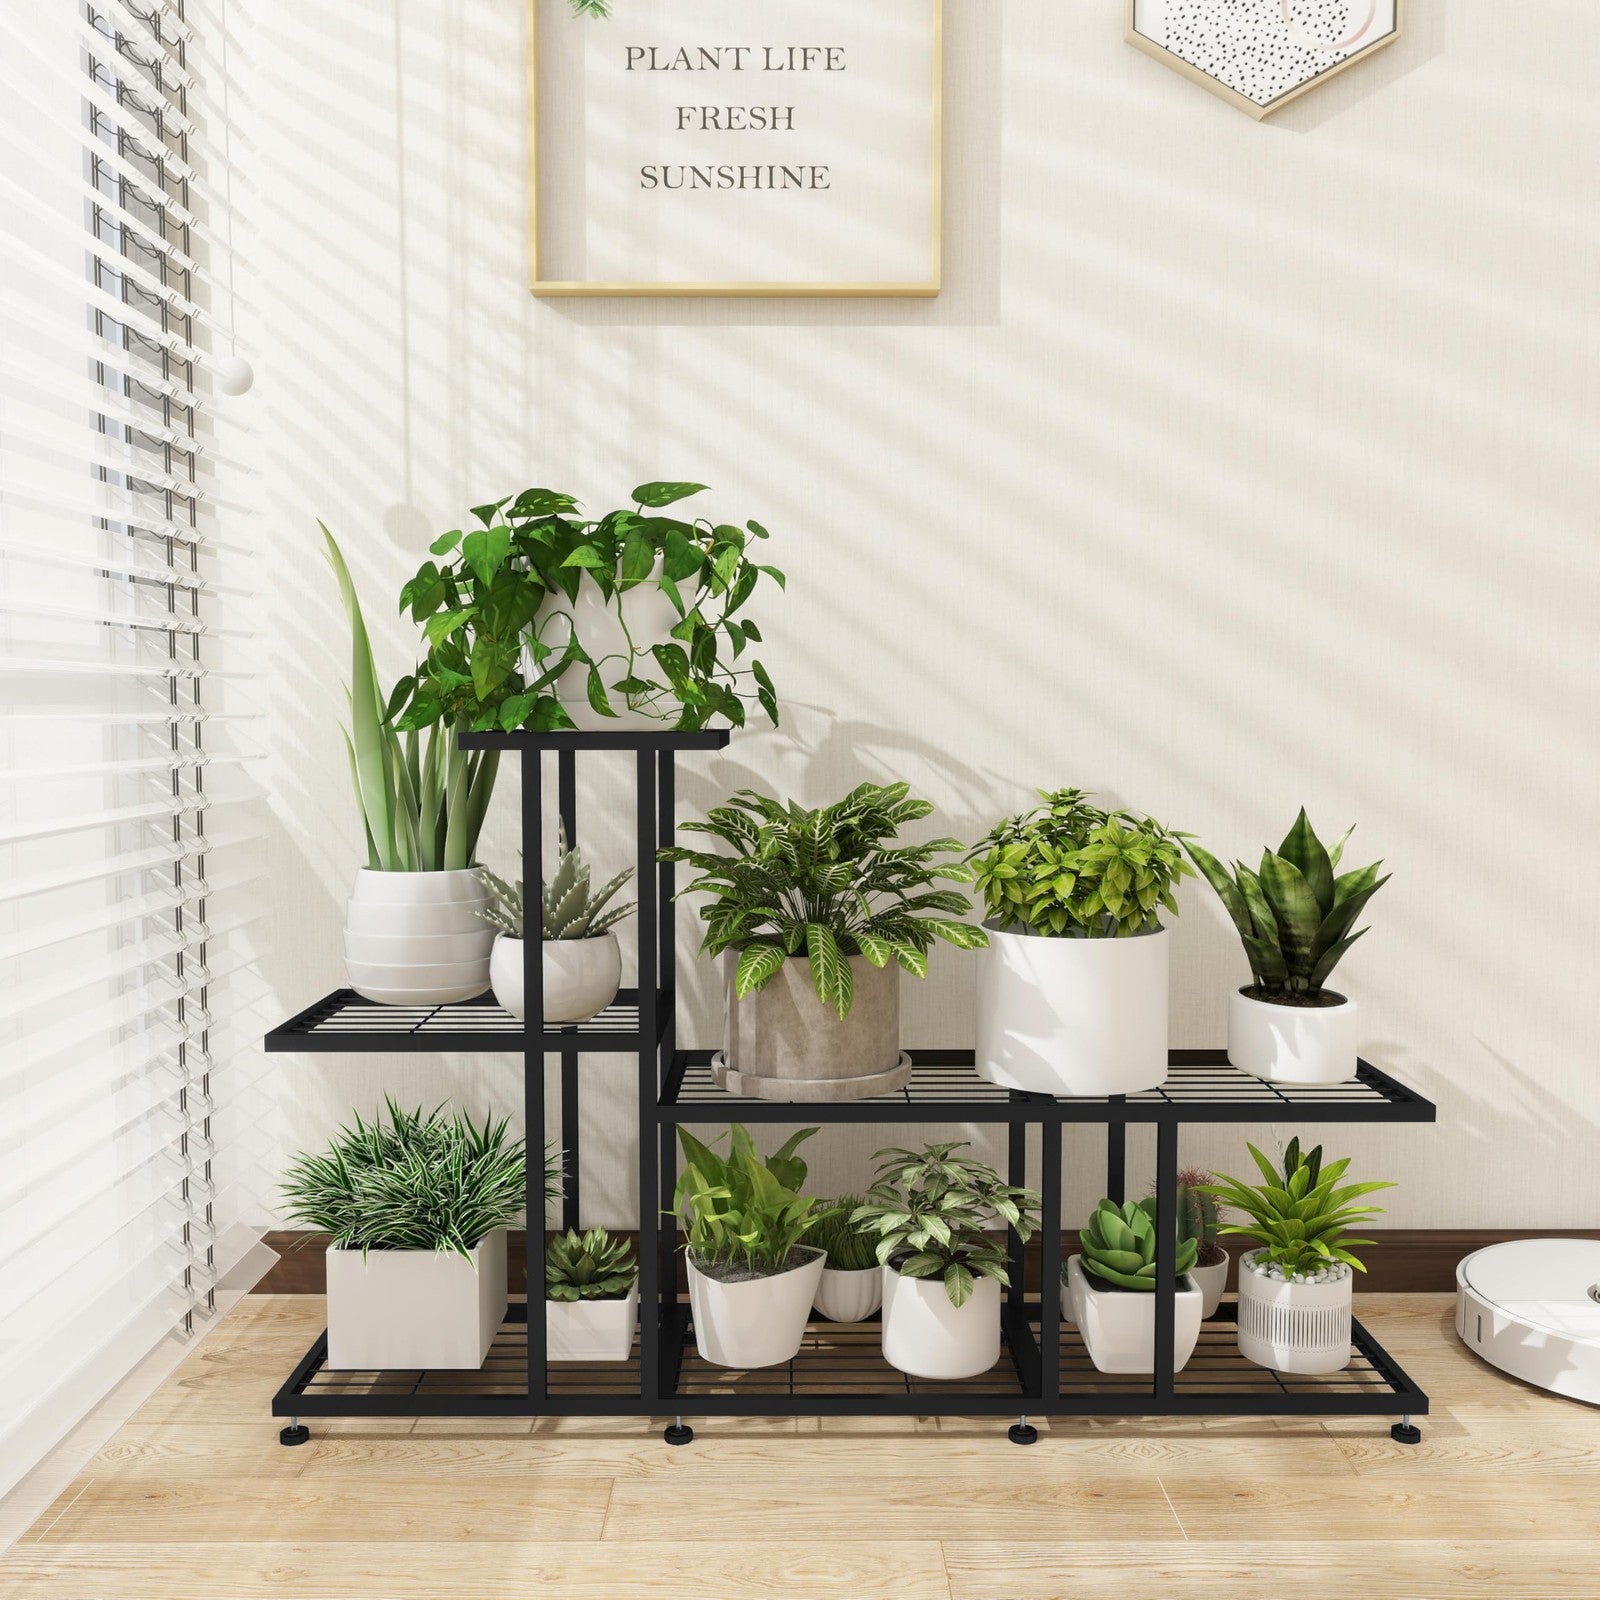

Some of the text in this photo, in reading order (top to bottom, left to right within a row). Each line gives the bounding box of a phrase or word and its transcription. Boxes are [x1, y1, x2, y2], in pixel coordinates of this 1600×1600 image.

[625, 46, 847, 71] PLANT LIFE
[676, 106, 795, 130] FRESH
[640, 165, 831, 190] SUNSHINE
